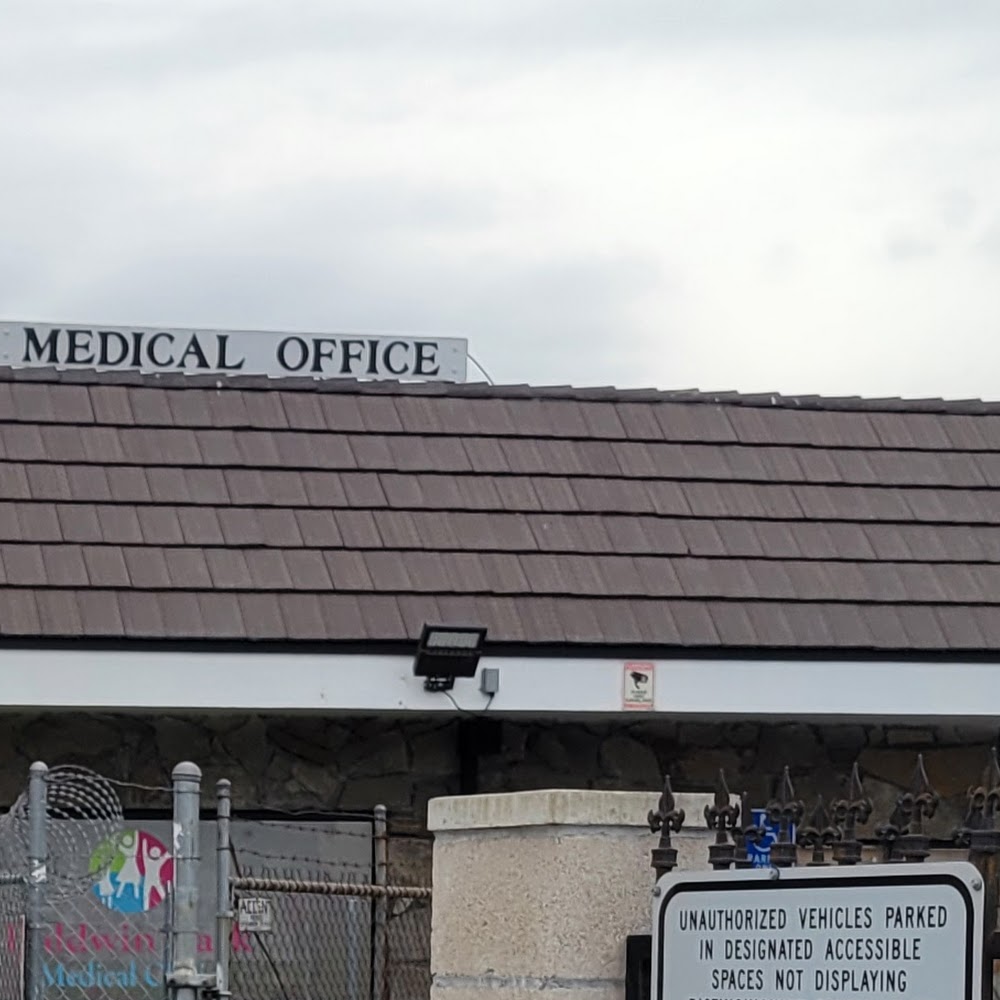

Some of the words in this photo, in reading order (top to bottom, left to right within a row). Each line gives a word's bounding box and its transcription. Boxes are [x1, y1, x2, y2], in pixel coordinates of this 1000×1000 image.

[22, 327, 246, 370] MEDICAL
[276, 336, 440, 377] OFFICE
[679, 909, 787, 931] UNAUTHORIZED
[799, 907, 873, 930] VEHICLES
[886, 905, 948, 929] PARKED
[699, 938, 714, 961] IN
[725, 938, 813, 961] DESIGNATED
[825, 938, 922, 961] ACCESSIBLE
[42, 959, 138, 988] Medical
[712, 968, 764, 991] SPACES
[775, 969, 804, 992] NOT
[815, 970, 907, 993] DISPLAYING
